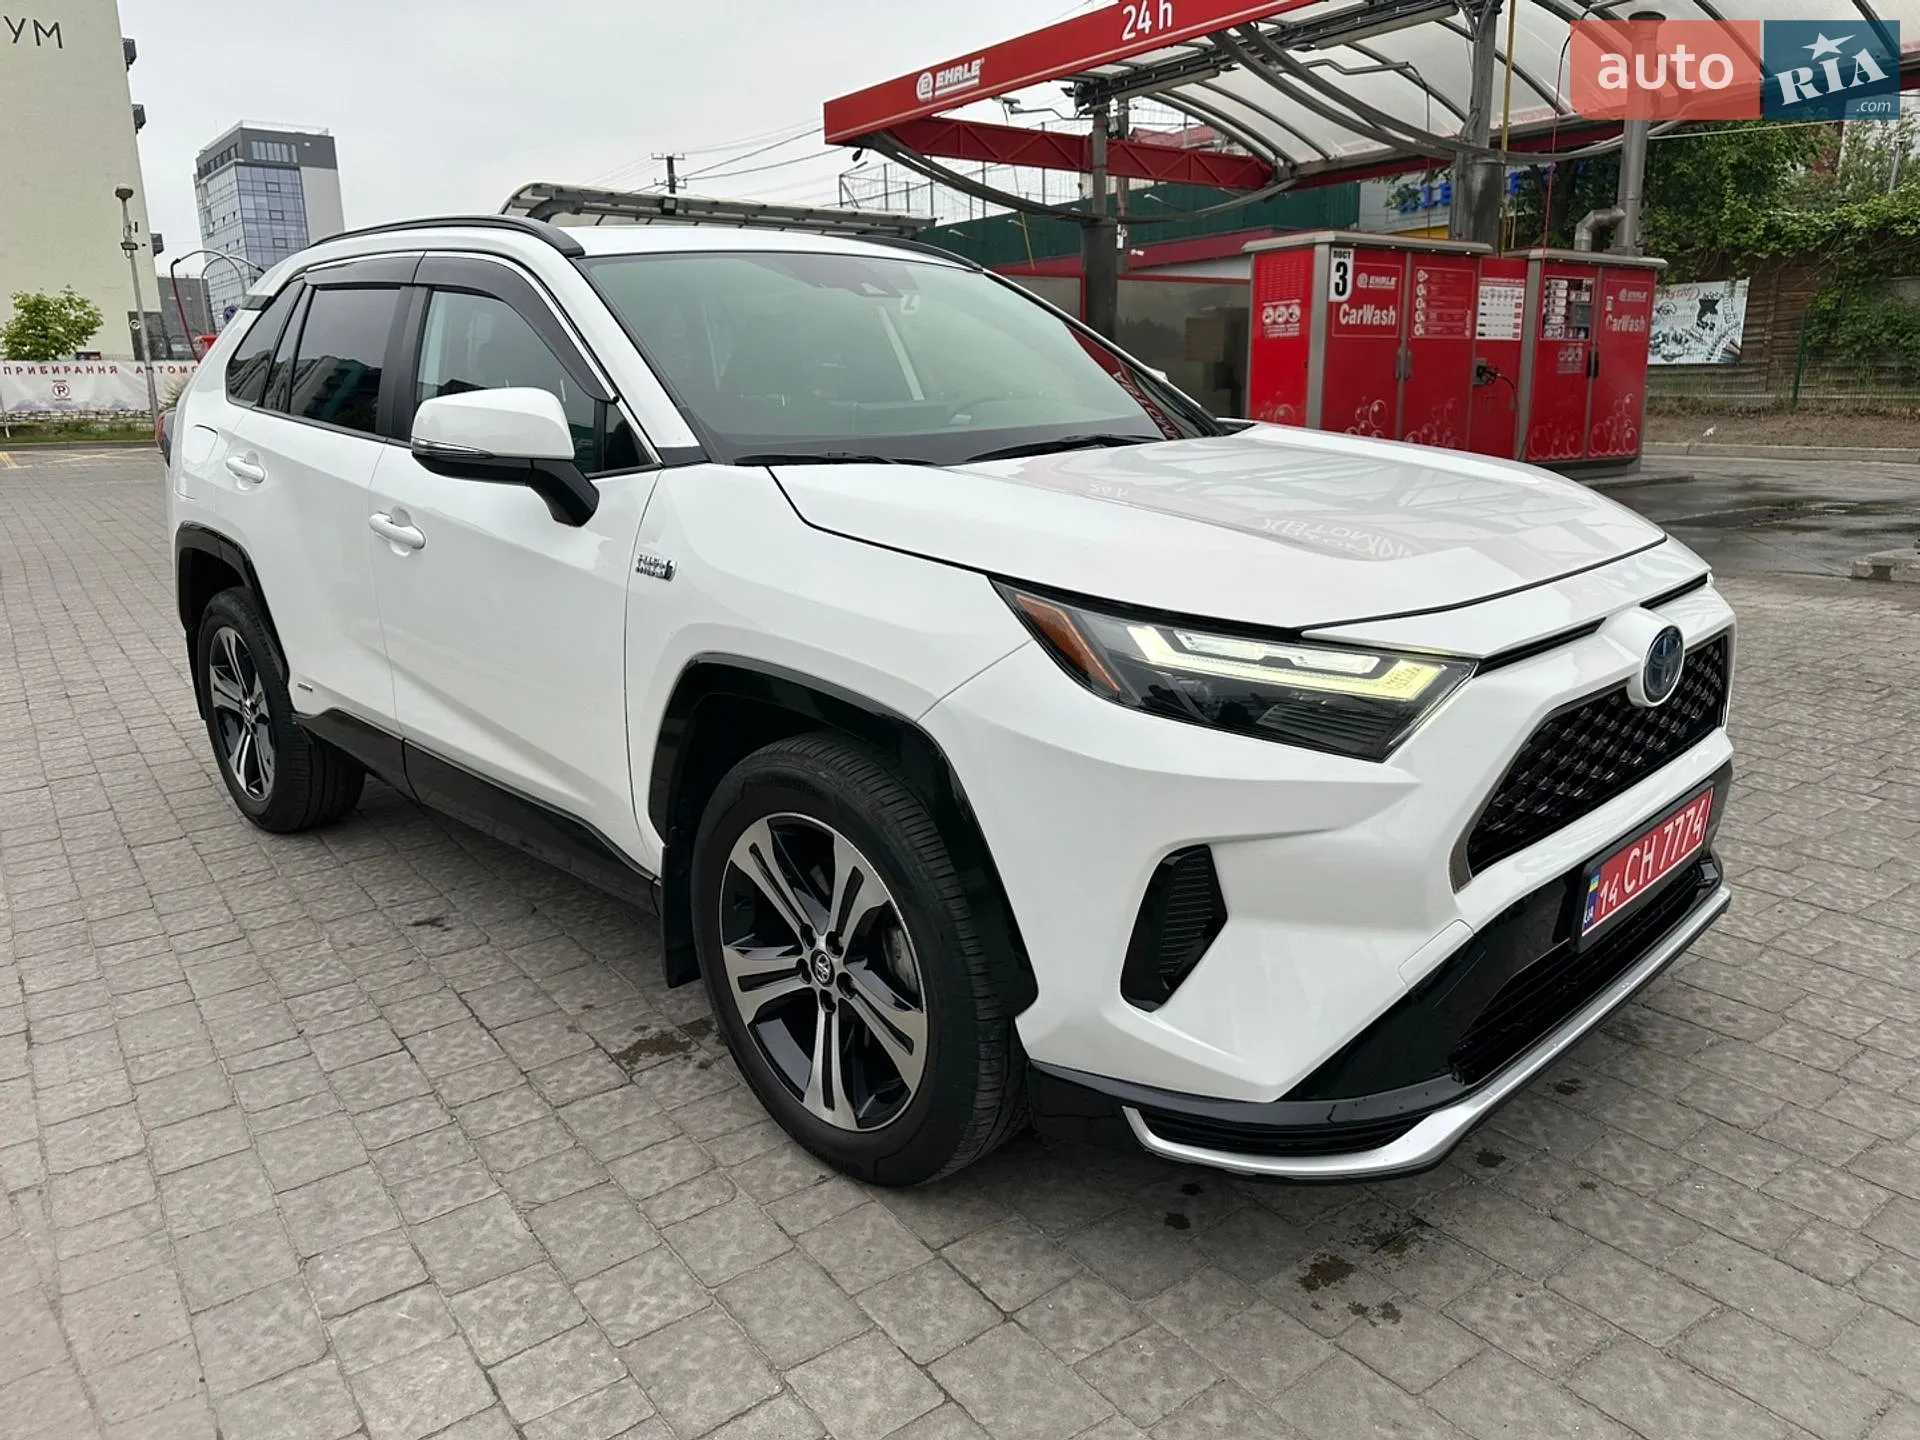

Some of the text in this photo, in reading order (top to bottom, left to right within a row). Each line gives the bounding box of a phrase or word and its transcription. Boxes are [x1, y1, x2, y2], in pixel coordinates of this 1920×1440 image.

[1122, 0, 1172, 40] 24 h
[935, 59, 981, 88] EHRLE
[1335, 261, 1348, 297] 3
[1339, 303, 1396, 325] CarWash
[1605, 314, 1646, 332] CarWash
[3, 365, 198, 376] ПРИБИРАННЯ АТОМ
[1623, 834, 1657, 895] CH
[1659, 799, 1706, 871] 7774
